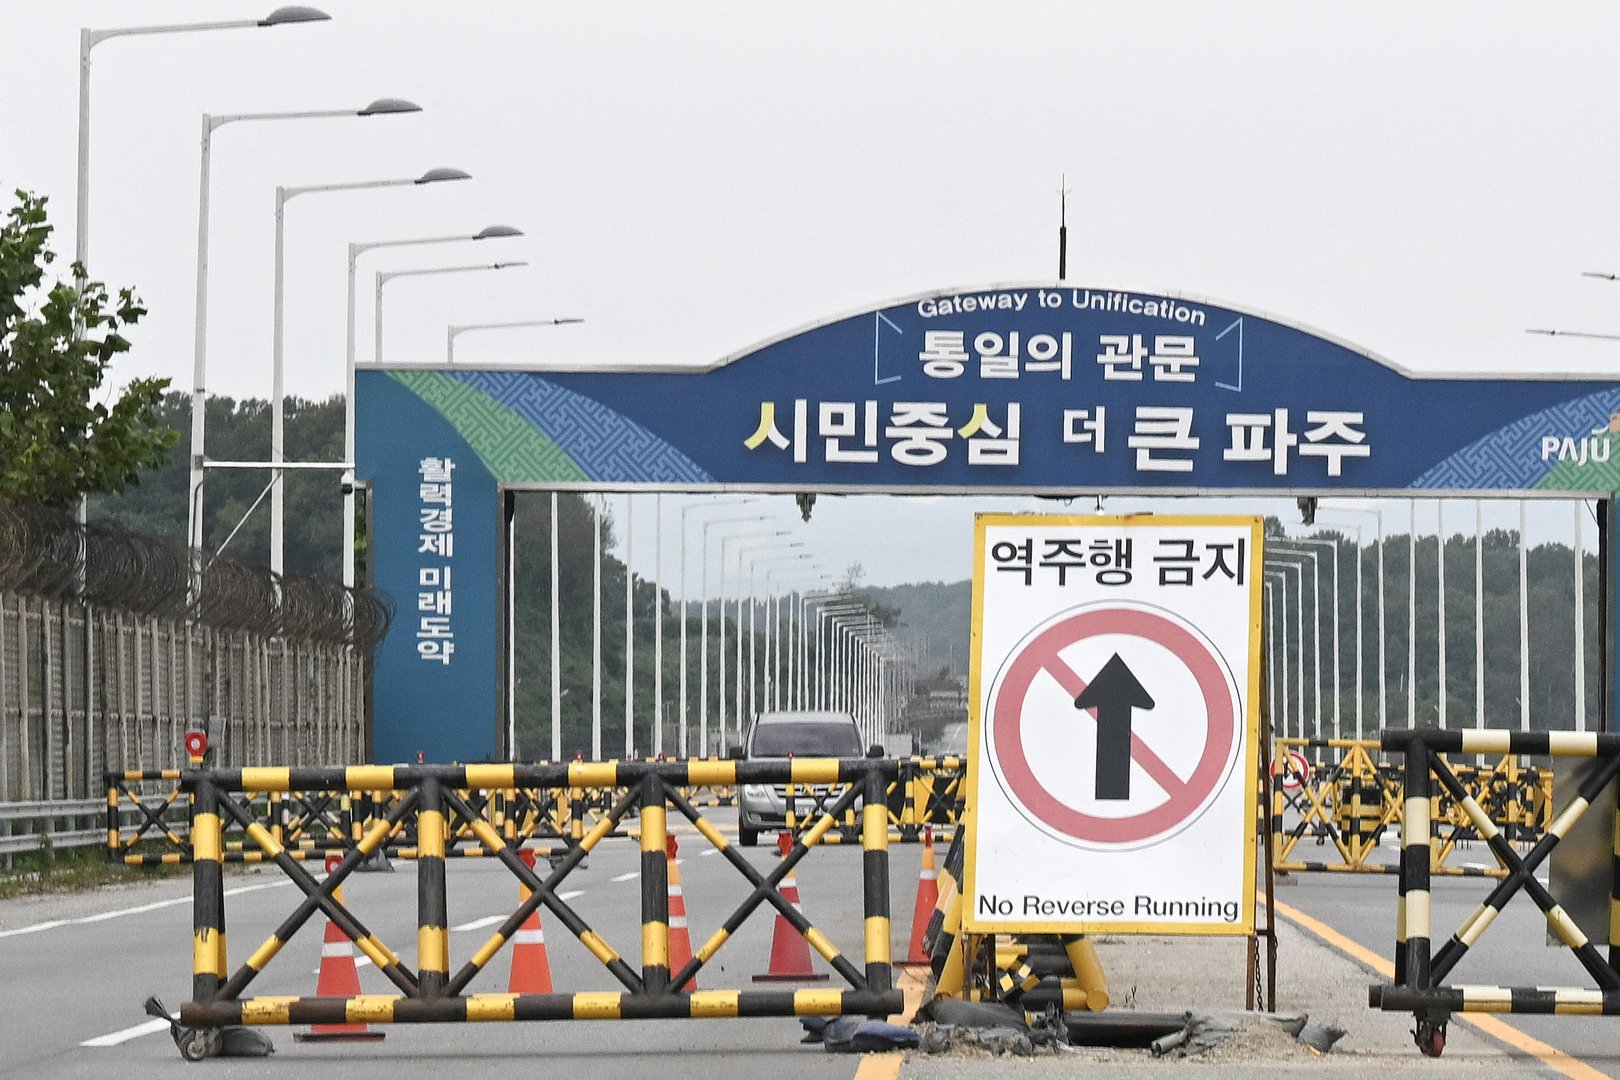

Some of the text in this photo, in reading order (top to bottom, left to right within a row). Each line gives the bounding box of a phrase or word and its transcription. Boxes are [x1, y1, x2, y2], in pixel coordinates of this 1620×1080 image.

[917, 289, 1206, 326] Gateway to Unification
[919, 330, 1200, 382] 통일의 관문
[743, 399, 1371, 477] 시민중심 더 큰 파주
[1541, 436, 1611, 467] PAJU
[416, 457, 456, 665] 활력경제 미래도약
[991, 538, 1245, 586] 역주행 금지
[979, 895, 1238, 922] No Reverse Running
